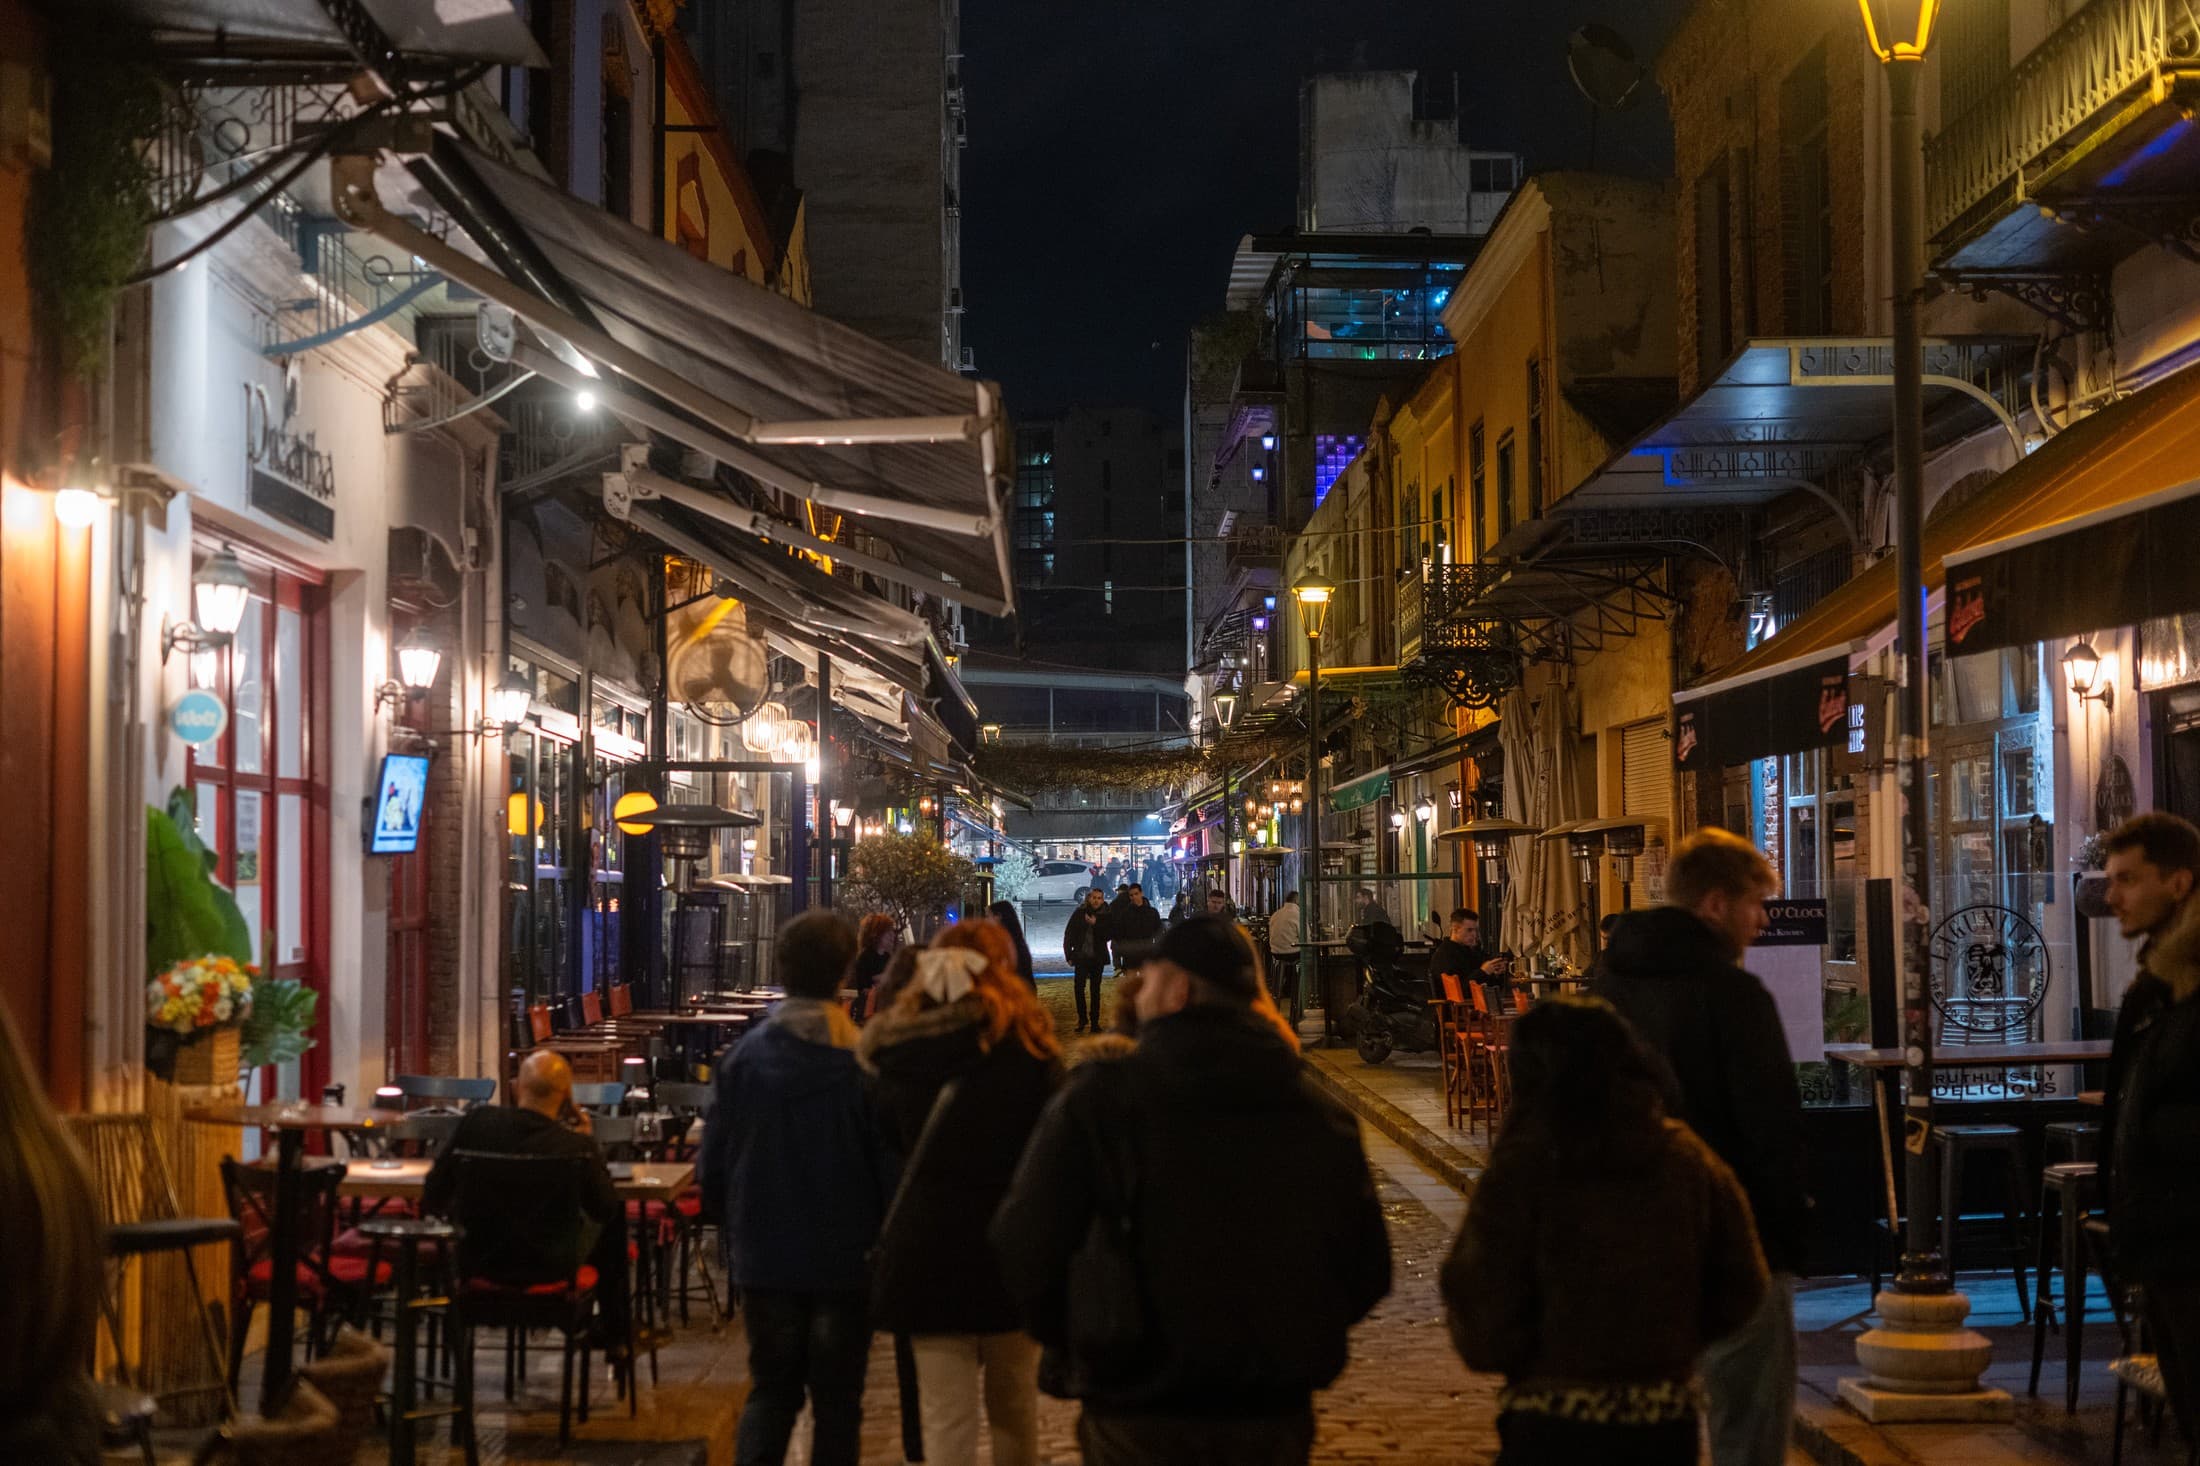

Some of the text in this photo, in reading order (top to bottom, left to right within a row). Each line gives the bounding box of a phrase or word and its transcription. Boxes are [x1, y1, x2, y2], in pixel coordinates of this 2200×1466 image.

[1930, 909, 2042, 961] LAGUNITAS
[1935, 1071, 2055, 1084] RUTHLESSLY
[1935, 1081, 2057, 1097] DELICIOUS
